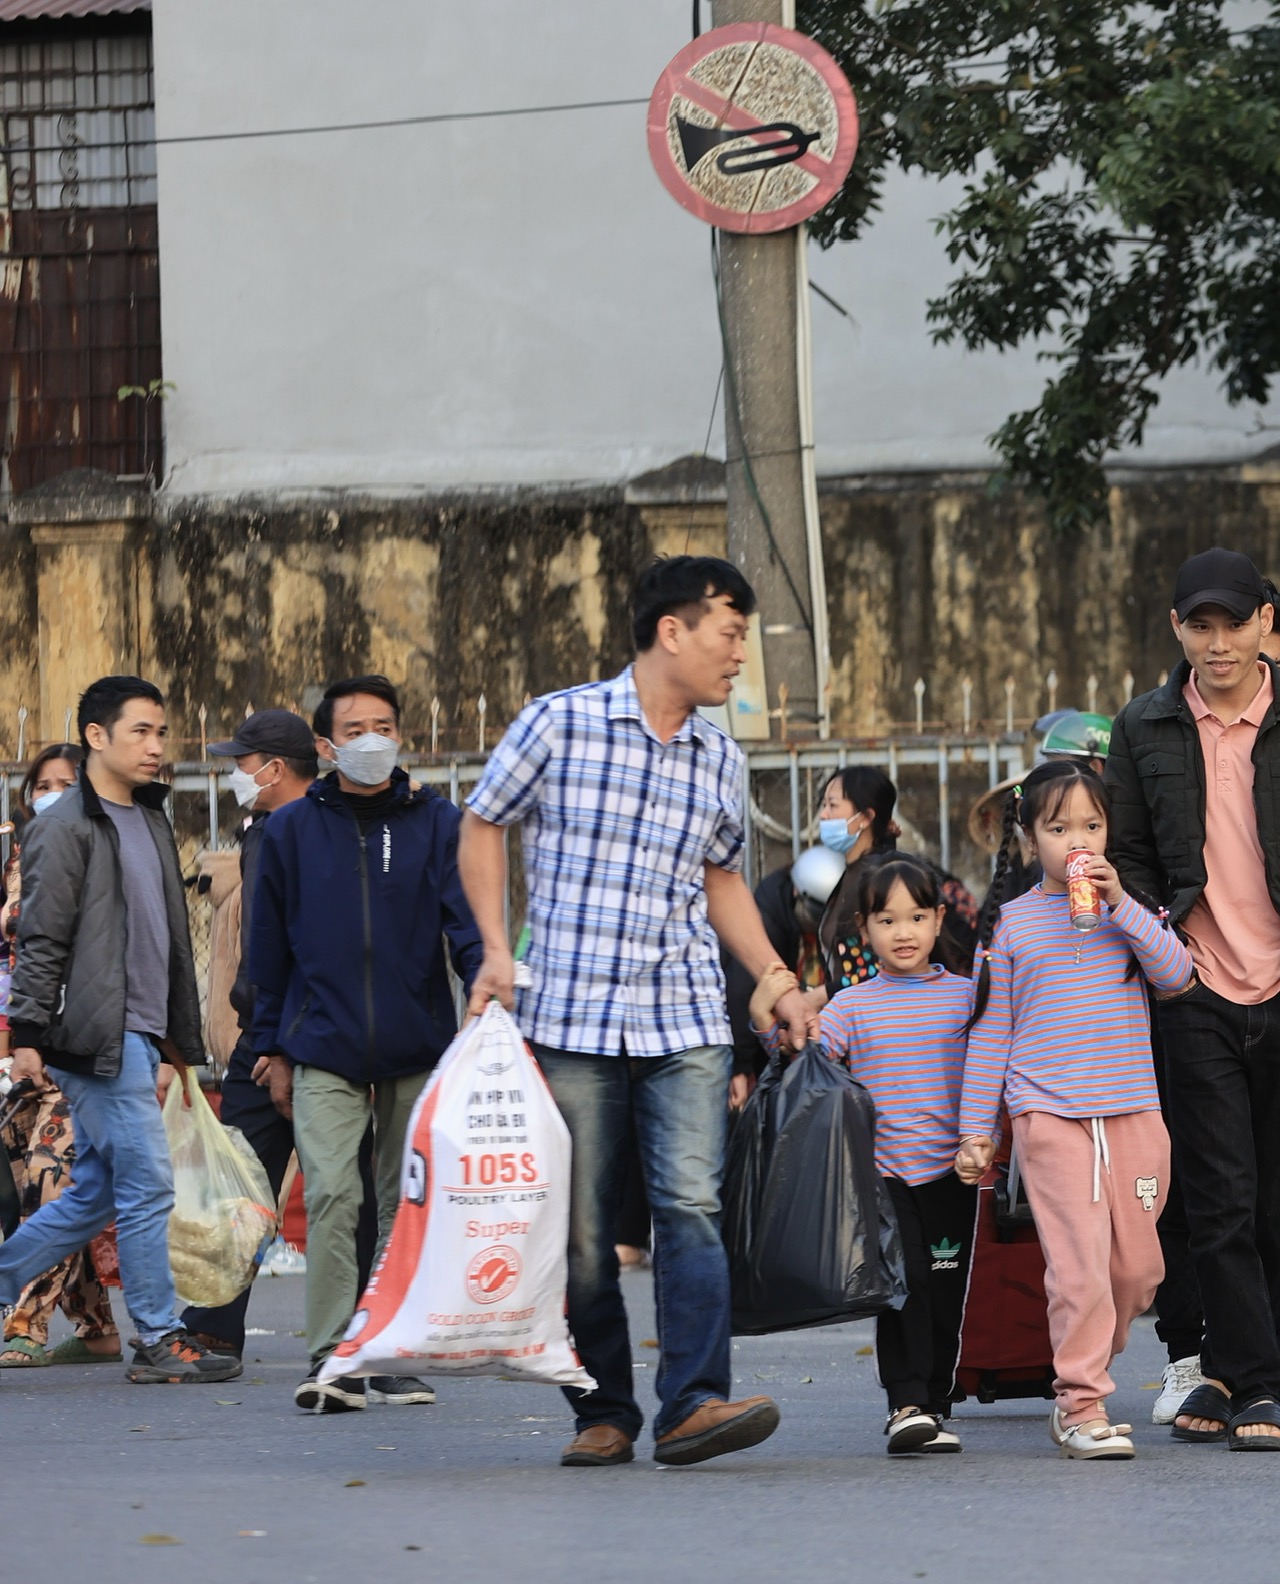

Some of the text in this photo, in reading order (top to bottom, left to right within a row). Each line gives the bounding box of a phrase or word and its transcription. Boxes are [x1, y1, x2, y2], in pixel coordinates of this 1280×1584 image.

[459, 1152, 538, 1185] 105S
[448, 1190, 549, 1205] POULTRY LAYER
[465, 1220, 529, 1241] Super
[428, 1306, 536, 1326] GOLD COIN GROUP
